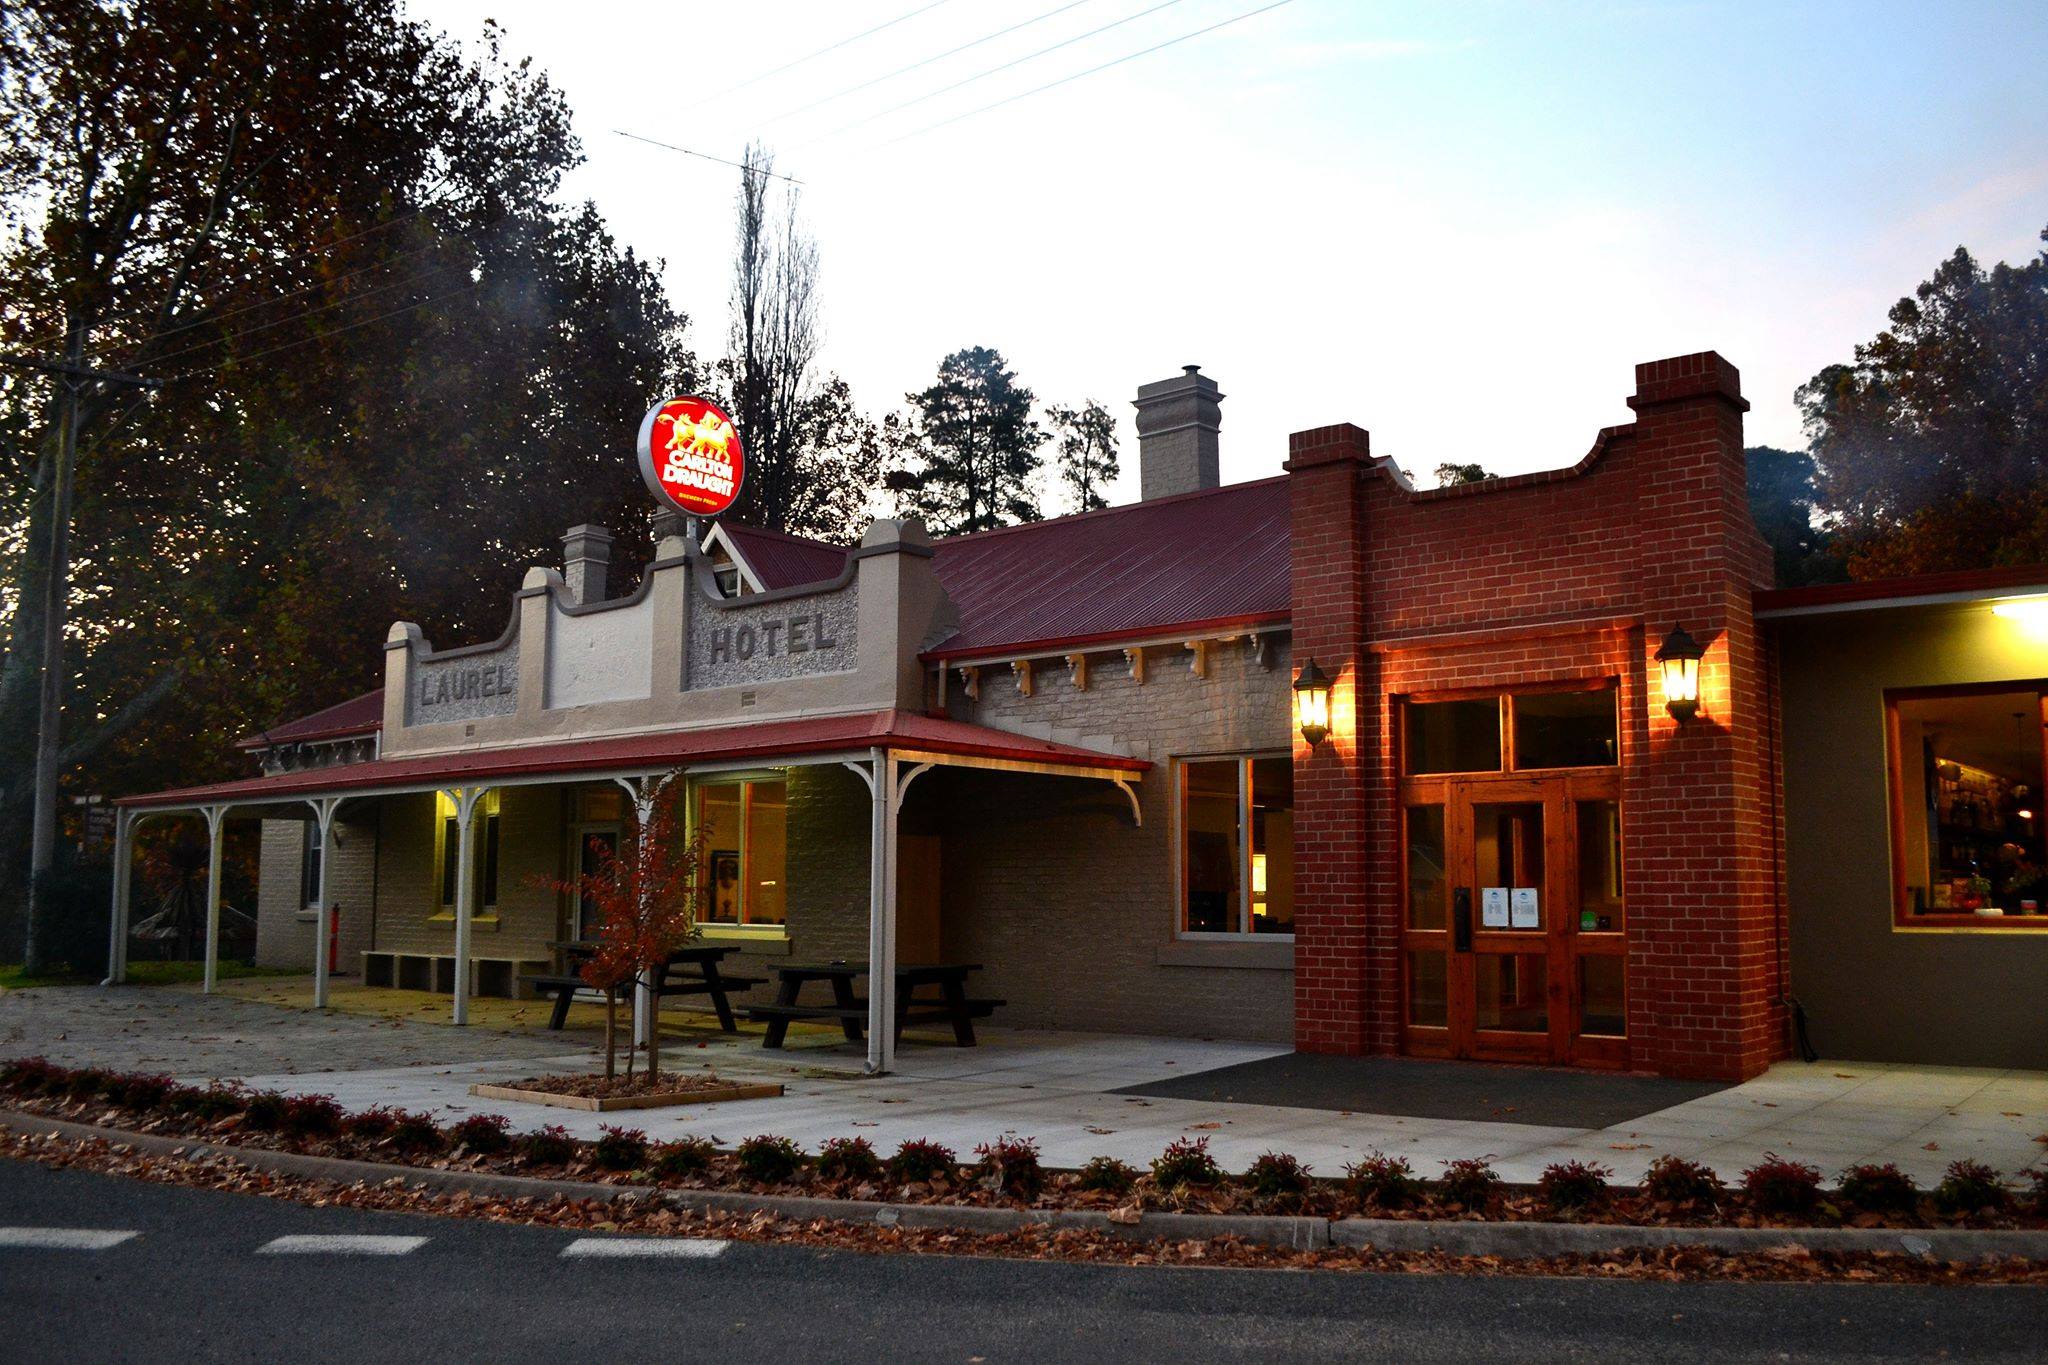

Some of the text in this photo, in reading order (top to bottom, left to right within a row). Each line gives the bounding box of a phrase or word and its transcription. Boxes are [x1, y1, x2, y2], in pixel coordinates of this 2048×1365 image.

[662, 464, 734, 496] DRAUGHT
[669, 450, 733, 480] CARLTON
[421, 613, 836, 706] LAUREL HOTEL
